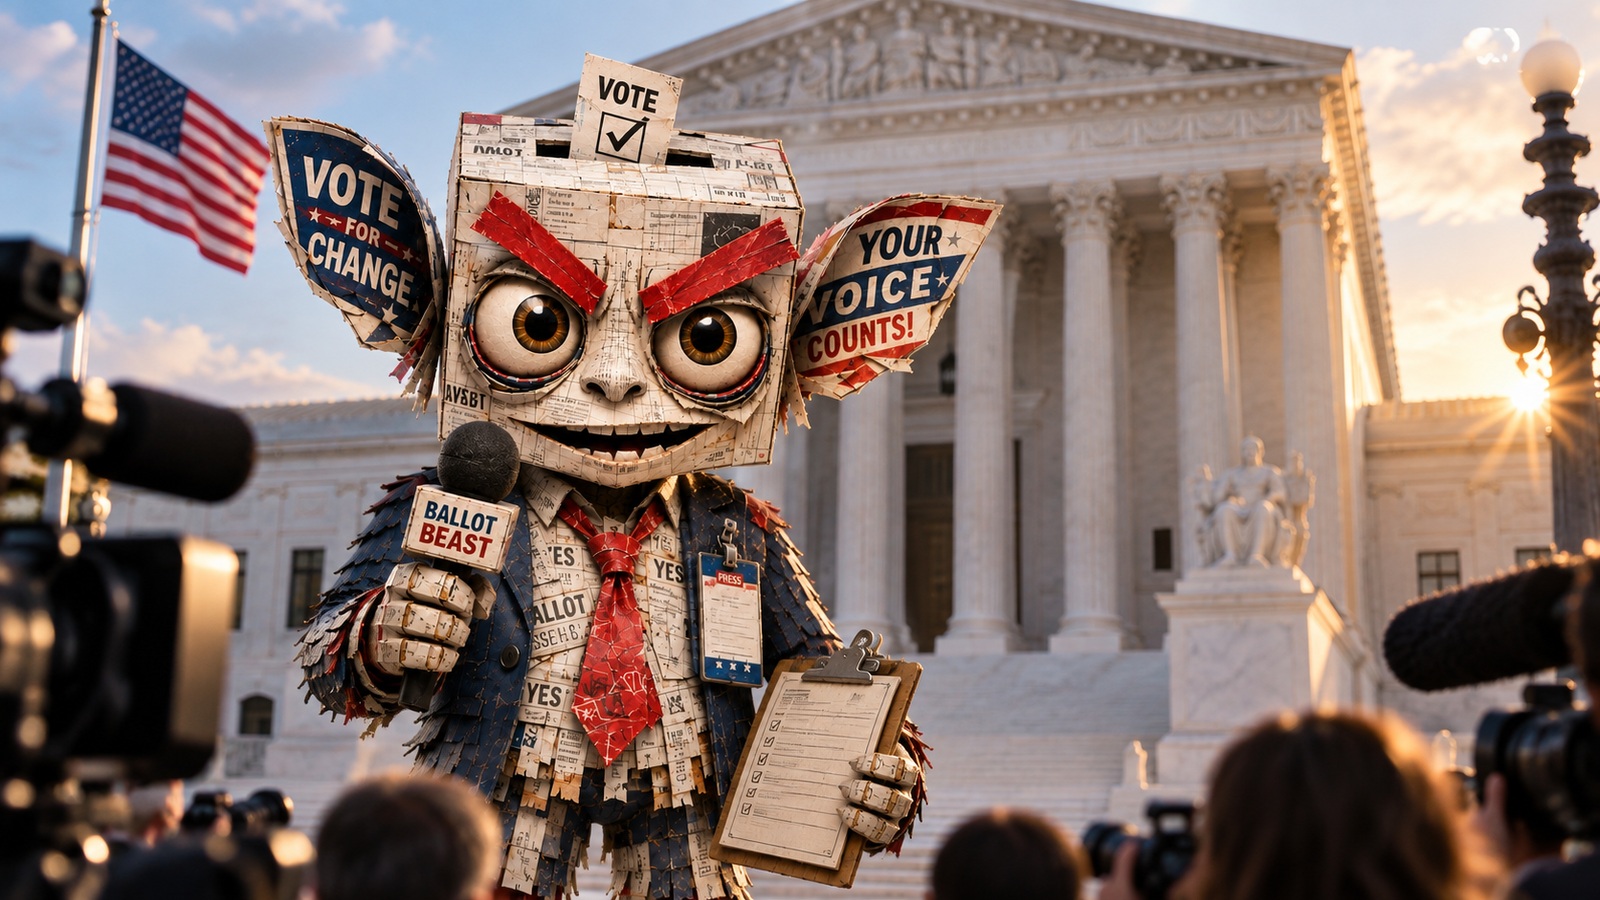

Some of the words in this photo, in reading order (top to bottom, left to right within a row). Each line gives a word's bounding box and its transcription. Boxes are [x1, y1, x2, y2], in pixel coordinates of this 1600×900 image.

[599, 75, 660, 113] VOTE
[303, 156, 402, 230] VOTE
[345, 217, 380, 247] FOR
[859, 225, 943, 265] YOUR
[308, 232, 415, 306] CHANGE
[809, 266, 933, 325] VOICE
[807, 311, 914, 363] COUNTS!
[424, 500, 498, 535] BALLOT
[419, 522, 493, 559] BEAST
[548, 546, 575, 567] ES
[654, 558, 684, 583] YES
[718, 572, 742, 586] PRESS
[527, 682, 562, 707] YES
